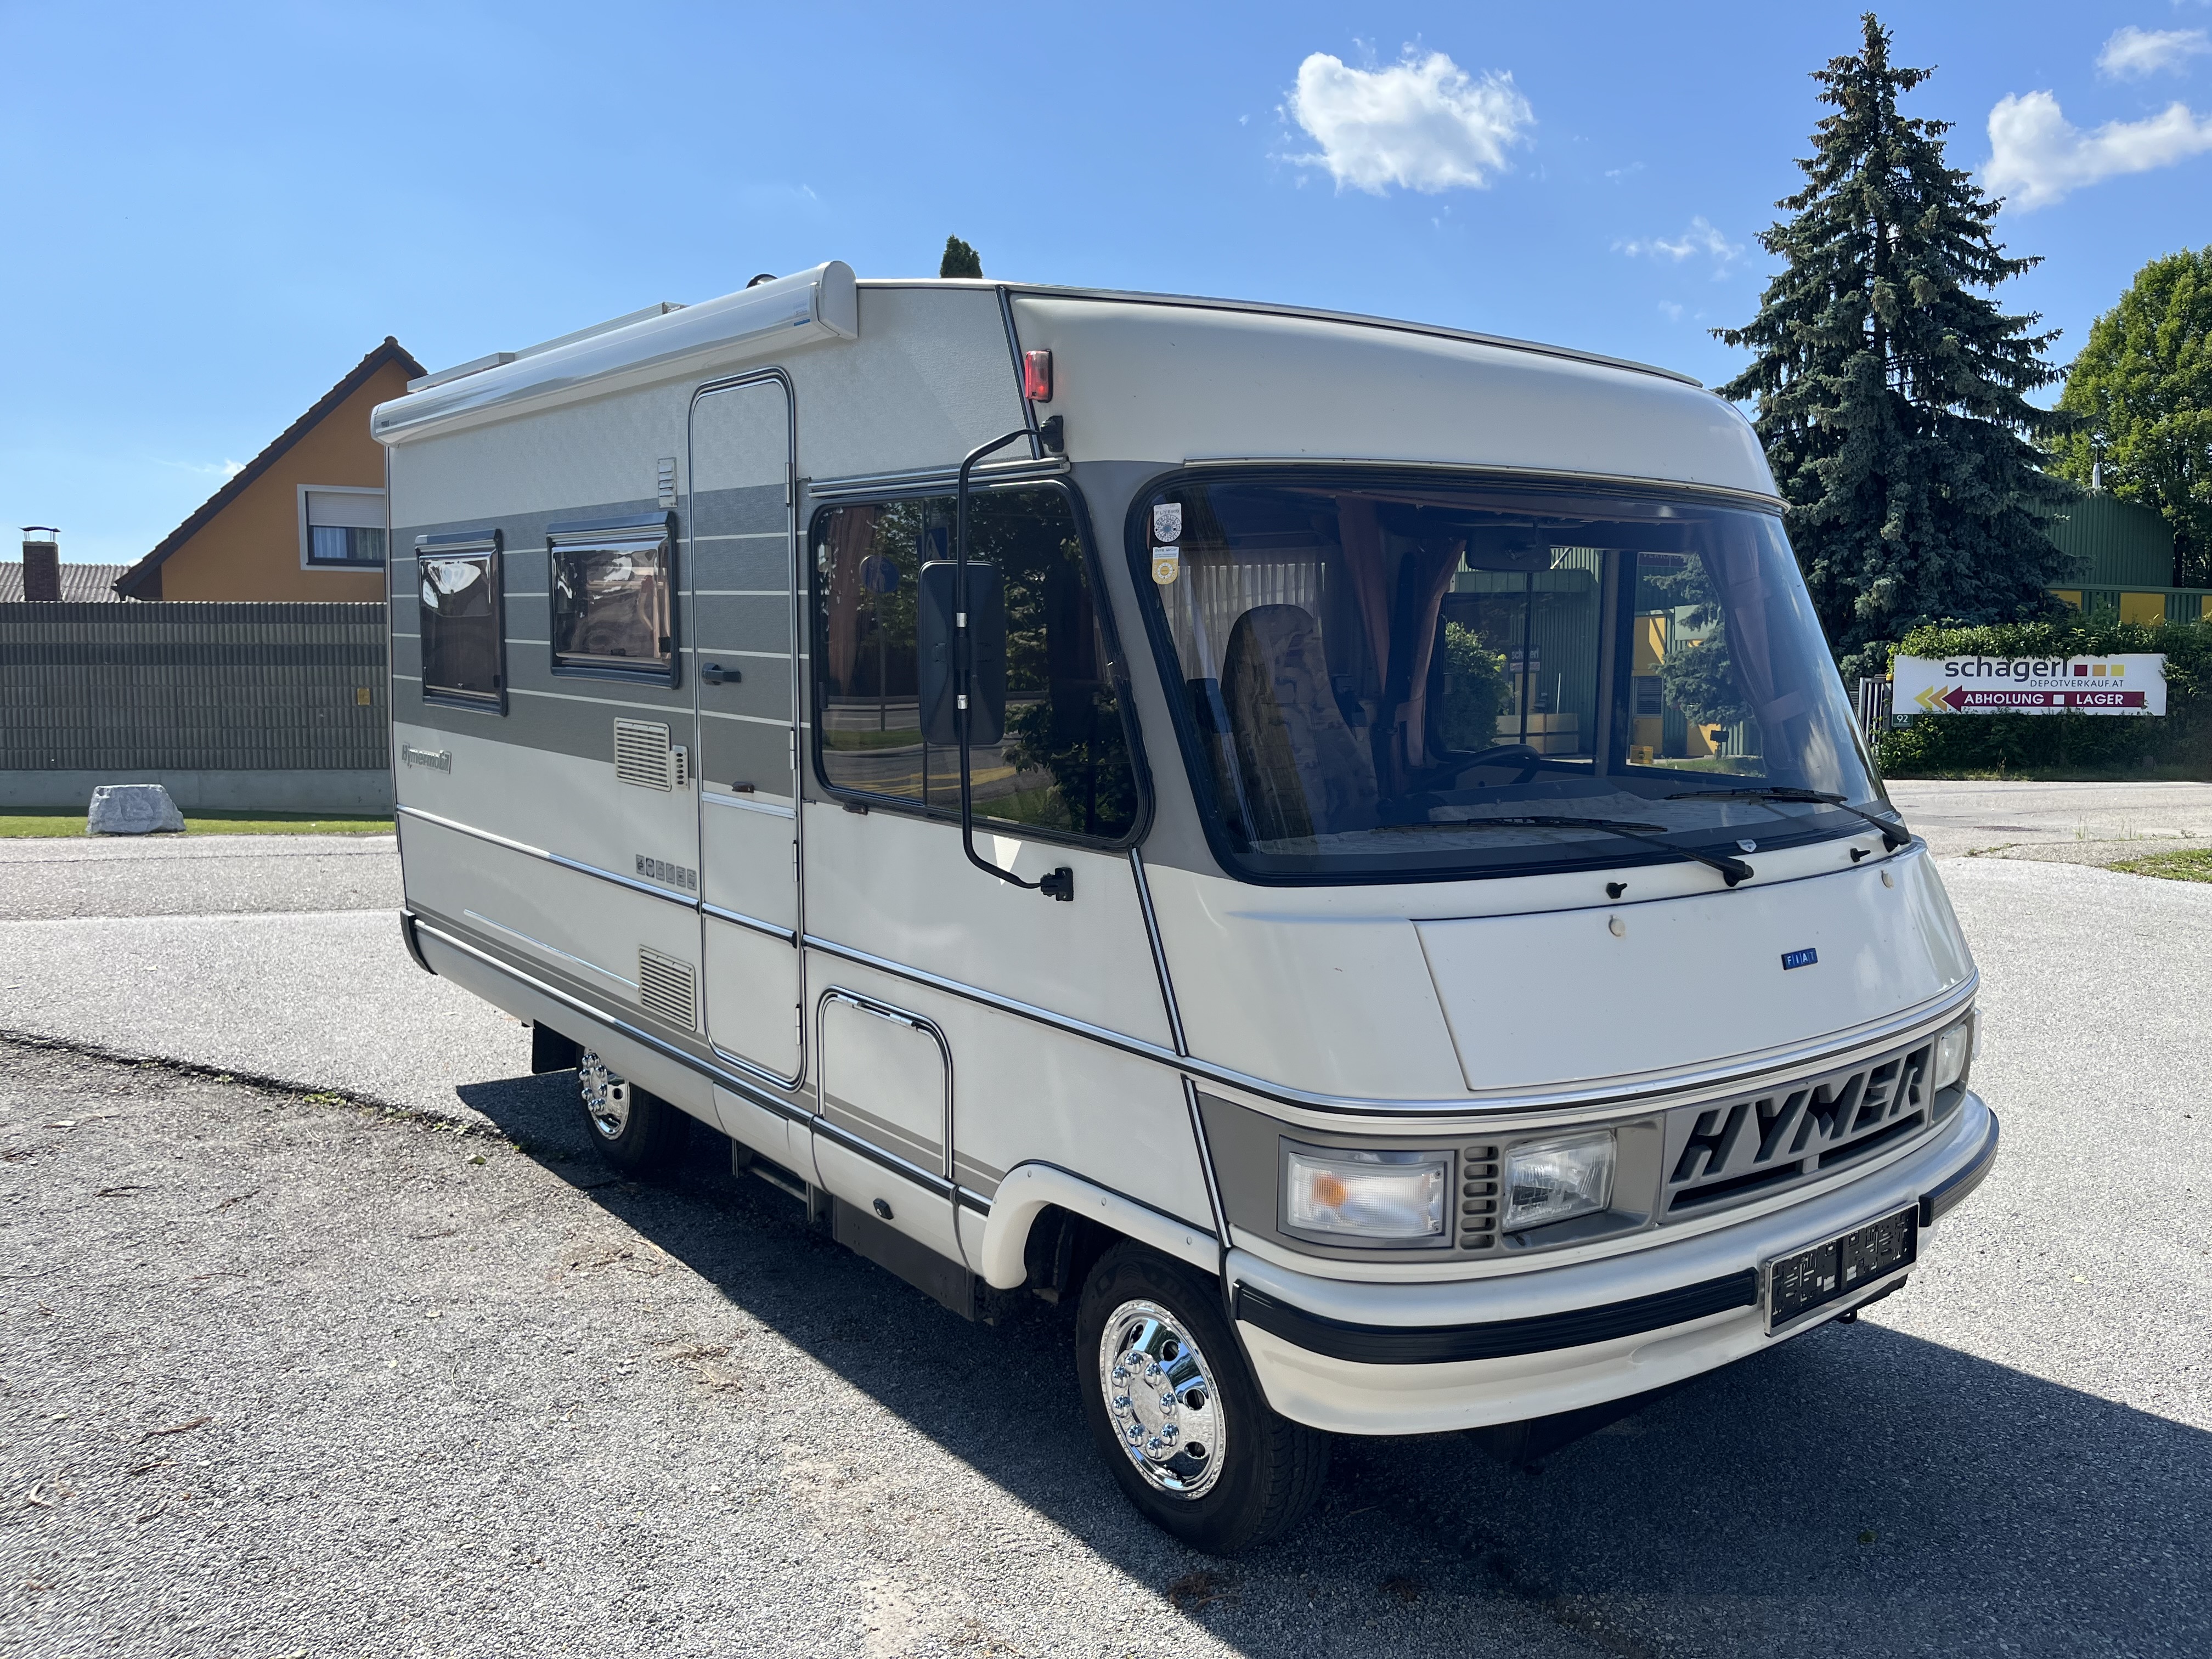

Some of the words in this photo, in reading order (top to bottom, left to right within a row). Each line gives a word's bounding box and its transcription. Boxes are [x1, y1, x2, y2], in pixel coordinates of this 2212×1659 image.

[1511, 647, 1539, 659] scherl
[1945, 655, 2067, 682] schagerl
[1963, 693, 2045, 704] ABHOLUNG
[2076, 693, 2124, 705] LAGER
[1897, 714, 1909, 723] 92
[1787, 951, 1815, 966] FIAT
[1669, 1042, 1932, 1184] HYMER
